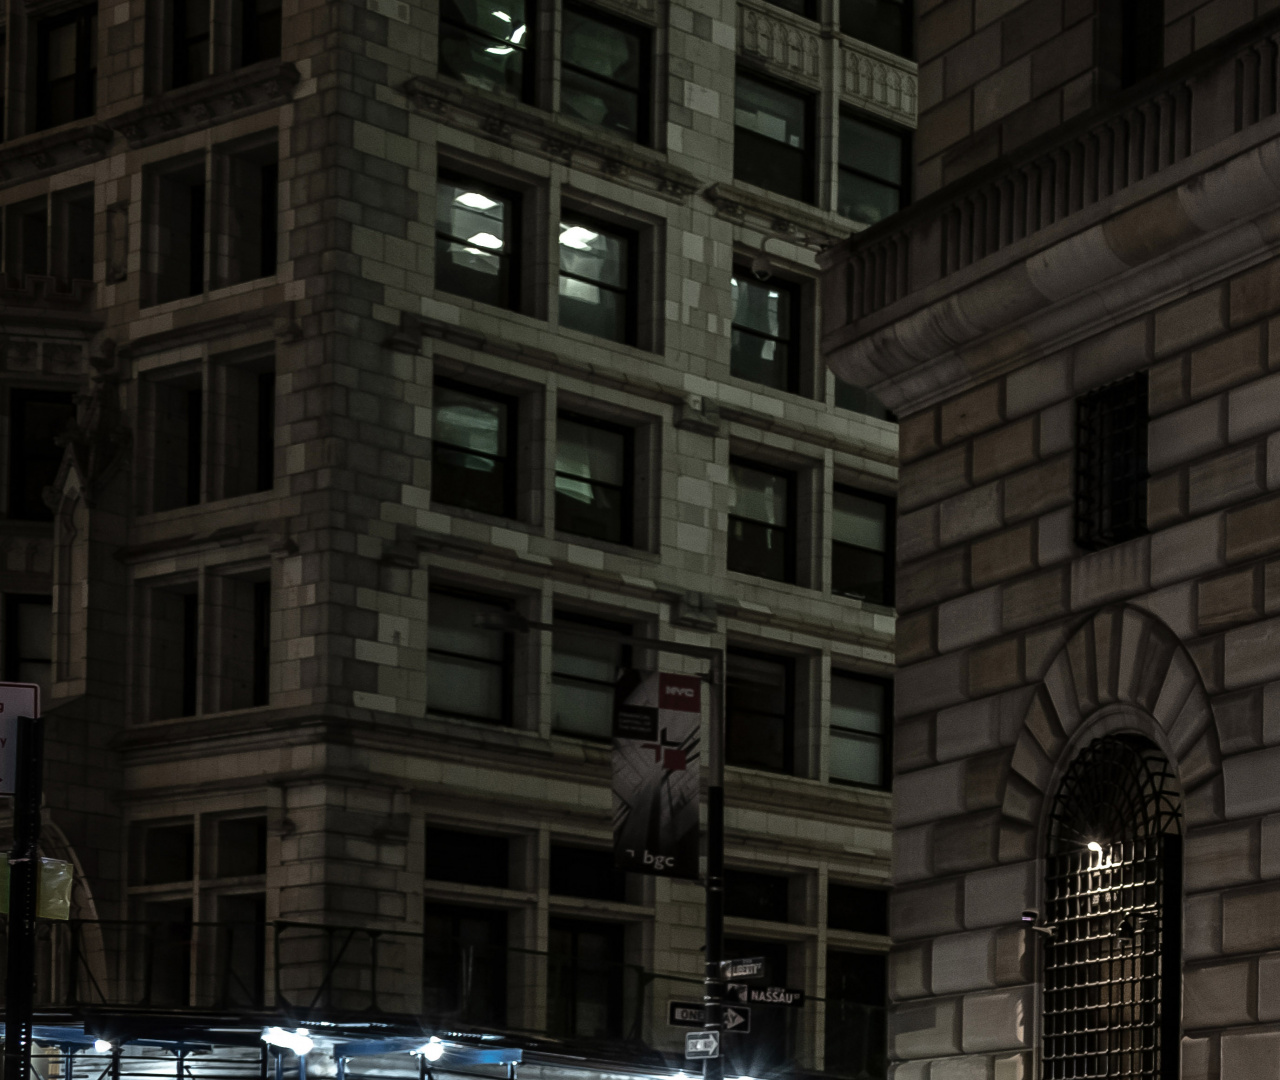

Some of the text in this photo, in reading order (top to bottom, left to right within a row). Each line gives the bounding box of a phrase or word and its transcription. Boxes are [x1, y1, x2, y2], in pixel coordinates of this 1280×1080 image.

[665, 685, 694, 698] NYC
[643, 849, 675, 870] bgc
[751, 989, 793, 1004] NASSAU
